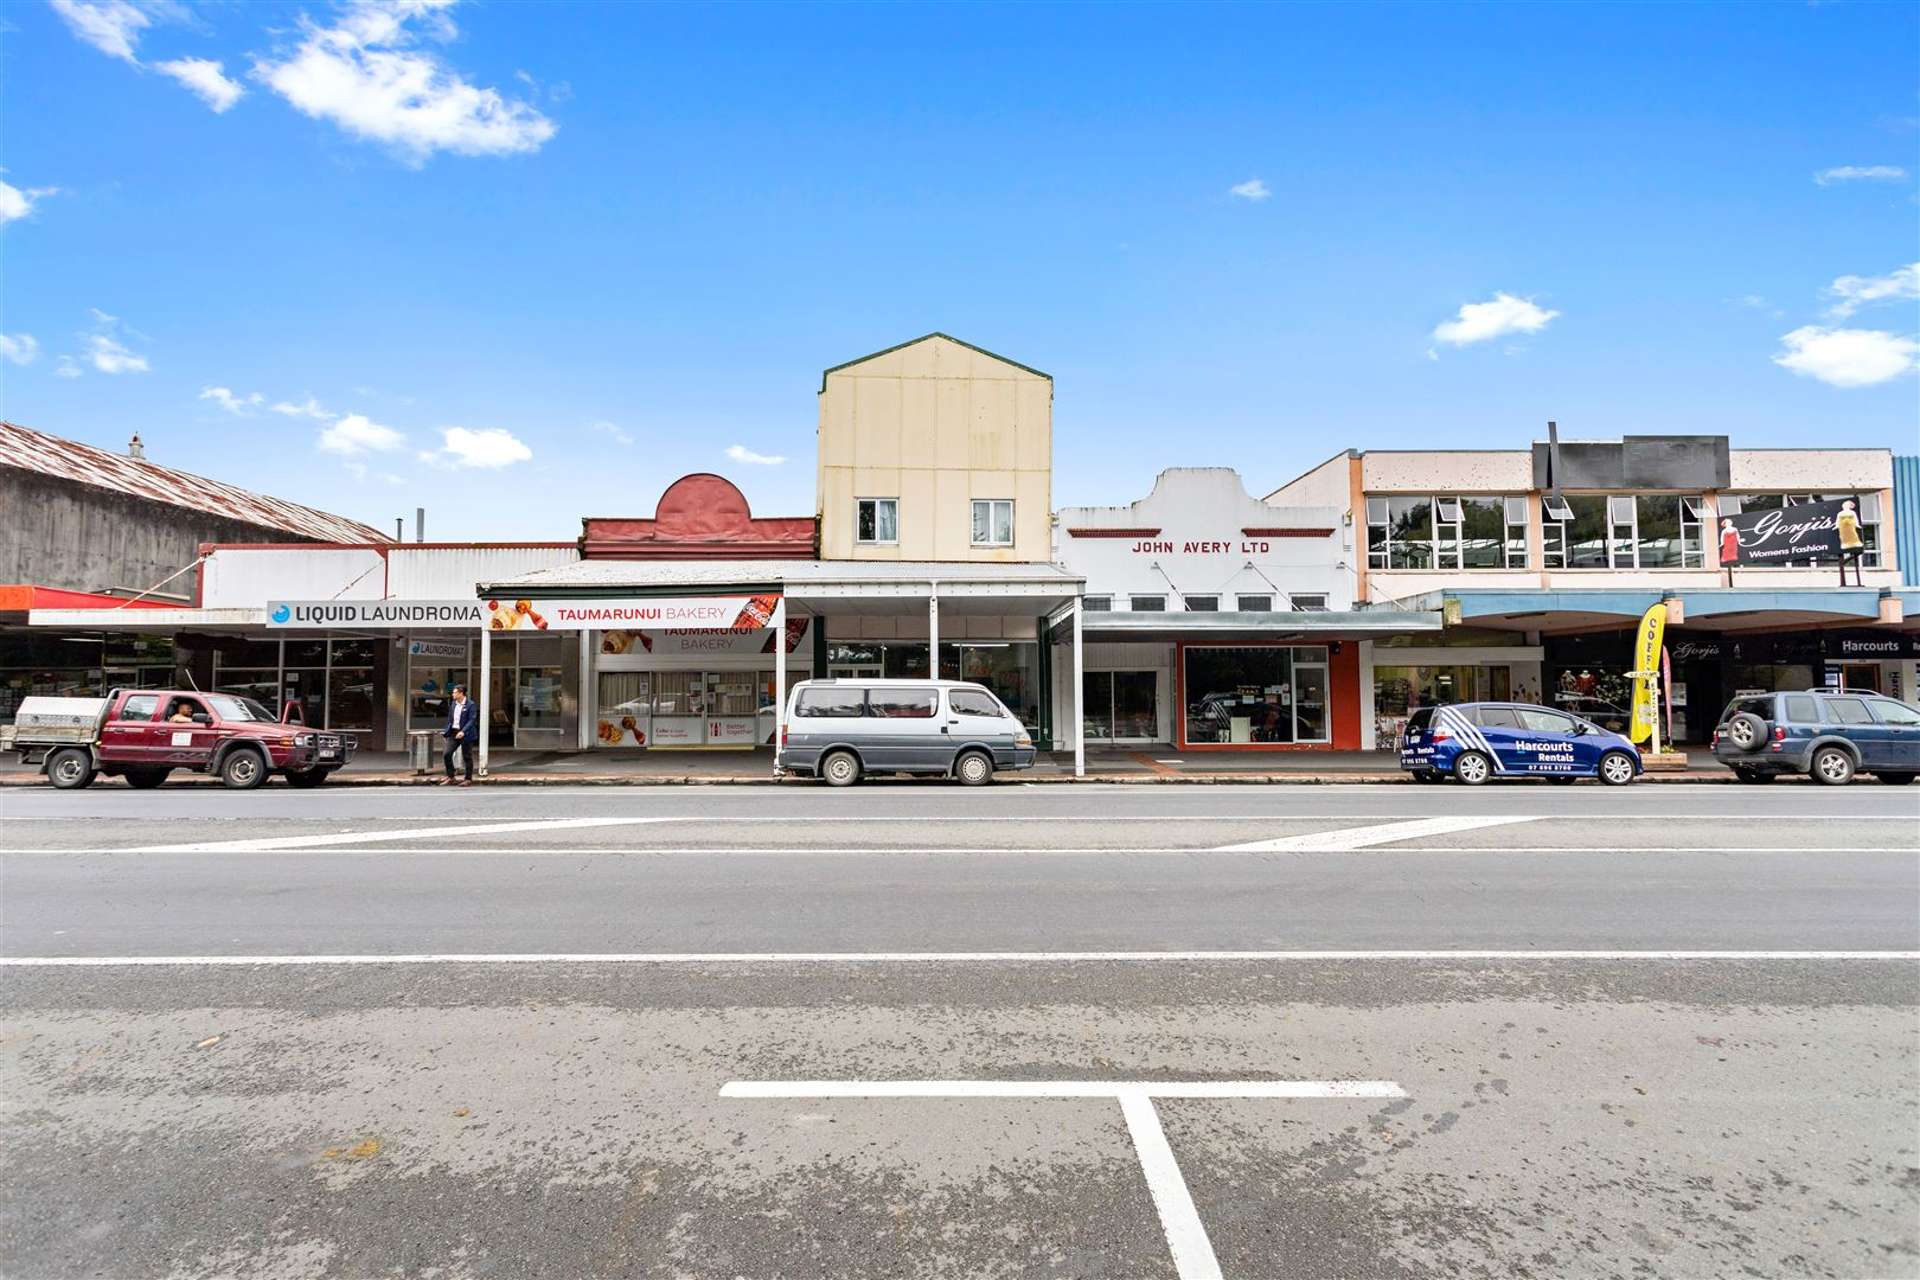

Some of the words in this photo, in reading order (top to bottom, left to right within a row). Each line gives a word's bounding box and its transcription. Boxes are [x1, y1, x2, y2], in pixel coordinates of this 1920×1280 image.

[1741, 510, 1838, 547] Gorjis
[1132, 542, 1173, 553] JOHN
[1183, 542, 1231, 553] AVERY
[1241, 542, 1269, 553] LTD
[1749, 548, 1789, 559] Womens
[1791, 543, 1828, 555] Fashion
[296, 606, 356, 624] LIQUID
[361, 606, 483, 621] LAUNDROMA
[558, 608, 661, 621] TAUMARUNUI
[666, 607, 727, 620] BAKERY
[420, 643, 465, 657] LAUNDROMAT
[681, 639, 733, 650] BAKERY
[1842, 640, 1900, 652] Harcourts
[1516, 740, 1574, 752] Harcourts
[1538, 753, 1574, 762] Rentals
